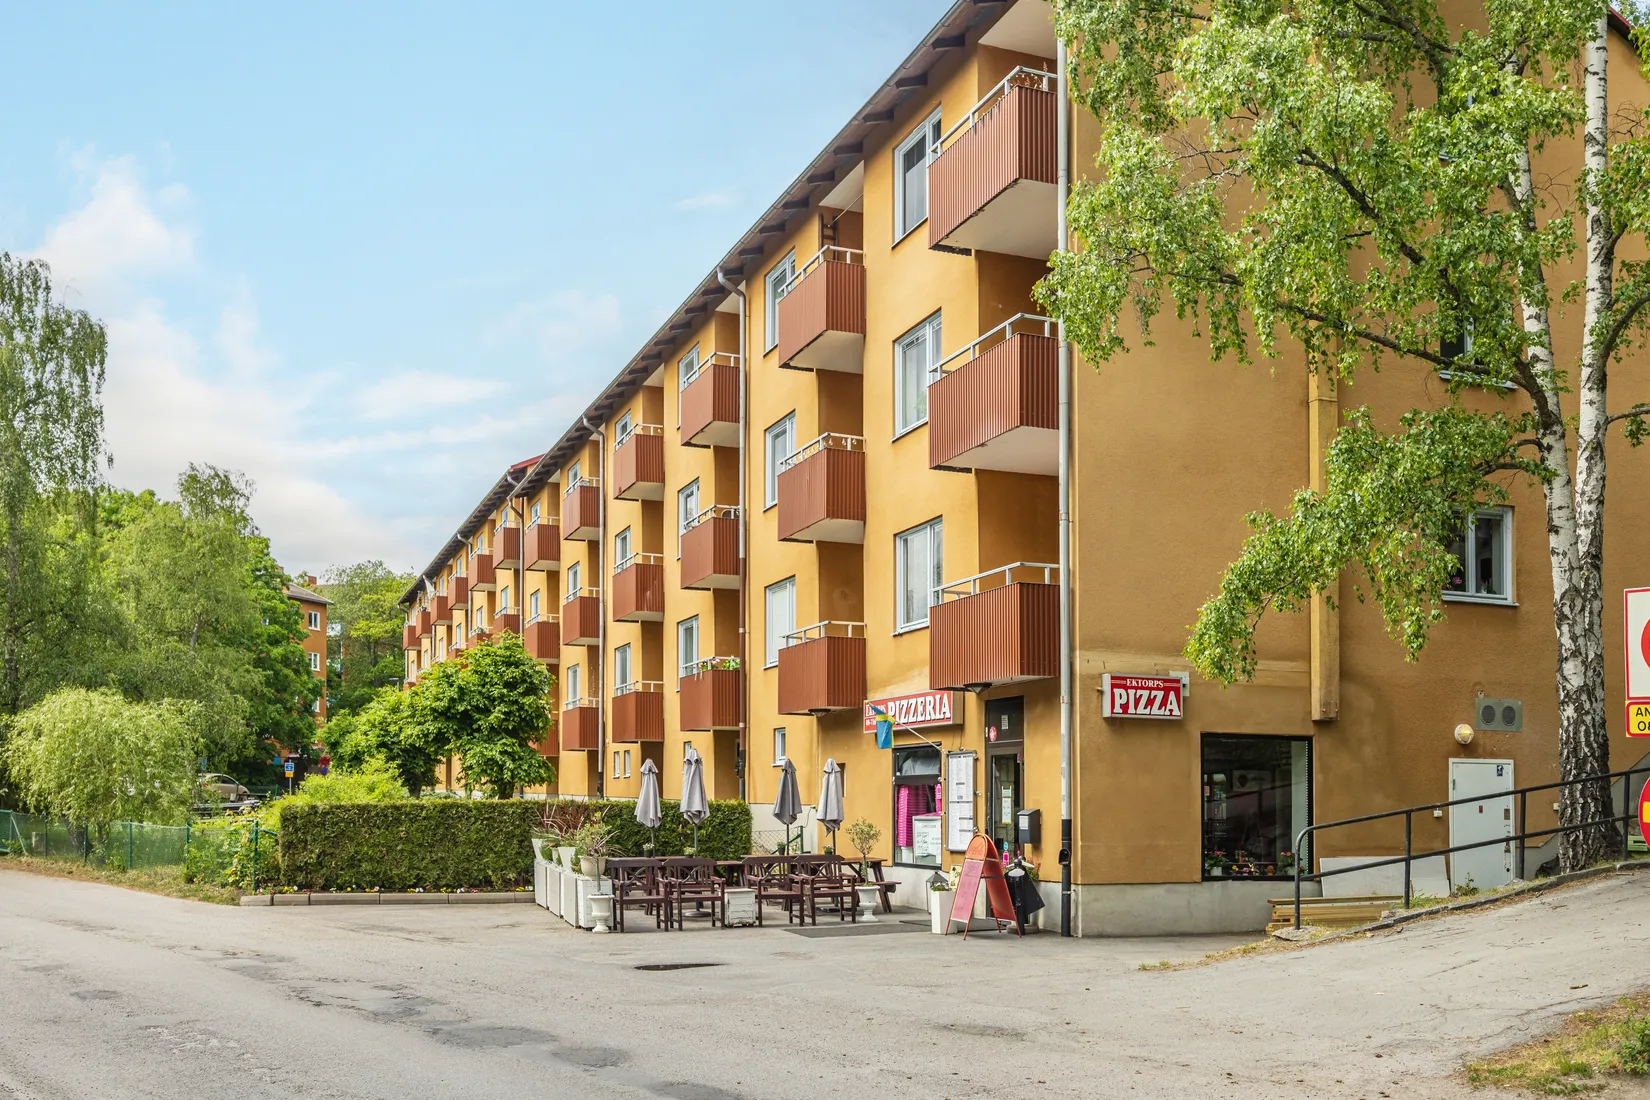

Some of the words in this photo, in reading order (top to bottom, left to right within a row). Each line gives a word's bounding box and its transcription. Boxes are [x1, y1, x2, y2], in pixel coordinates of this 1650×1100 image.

[1126, 678, 1164, 688] EKTORPS
[887, 692, 951, 724] PIZZERIA
[1113, 688, 1181, 716] PIZZA
